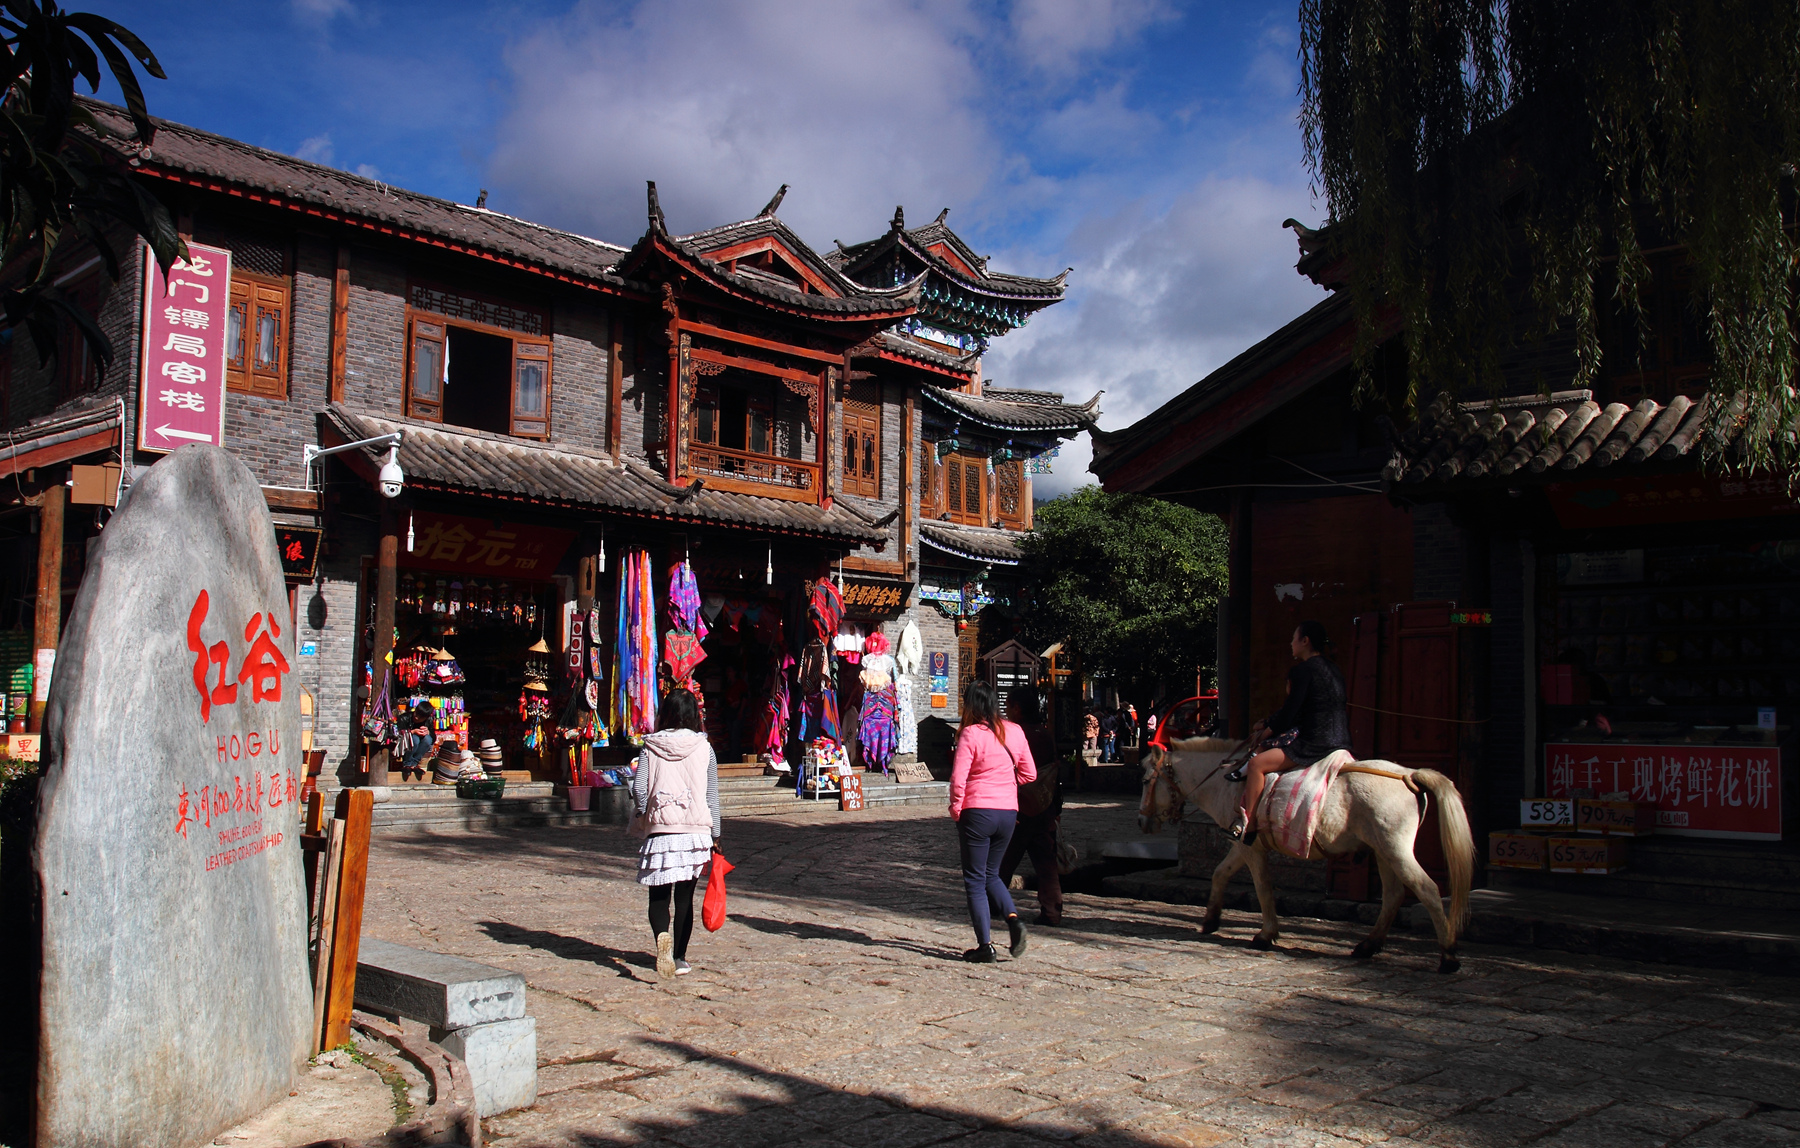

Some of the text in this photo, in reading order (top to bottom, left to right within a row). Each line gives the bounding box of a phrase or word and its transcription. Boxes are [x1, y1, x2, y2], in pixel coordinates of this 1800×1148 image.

[411, 521, 518, 566] 拾元
[514, 556, 539, 570] TEN
[186, 588, 291, 724] 红谷
[1551, 753, 1773, 810] 纯手工现烤鲜花饼
[205, 848, 237, 872] LEATHER
